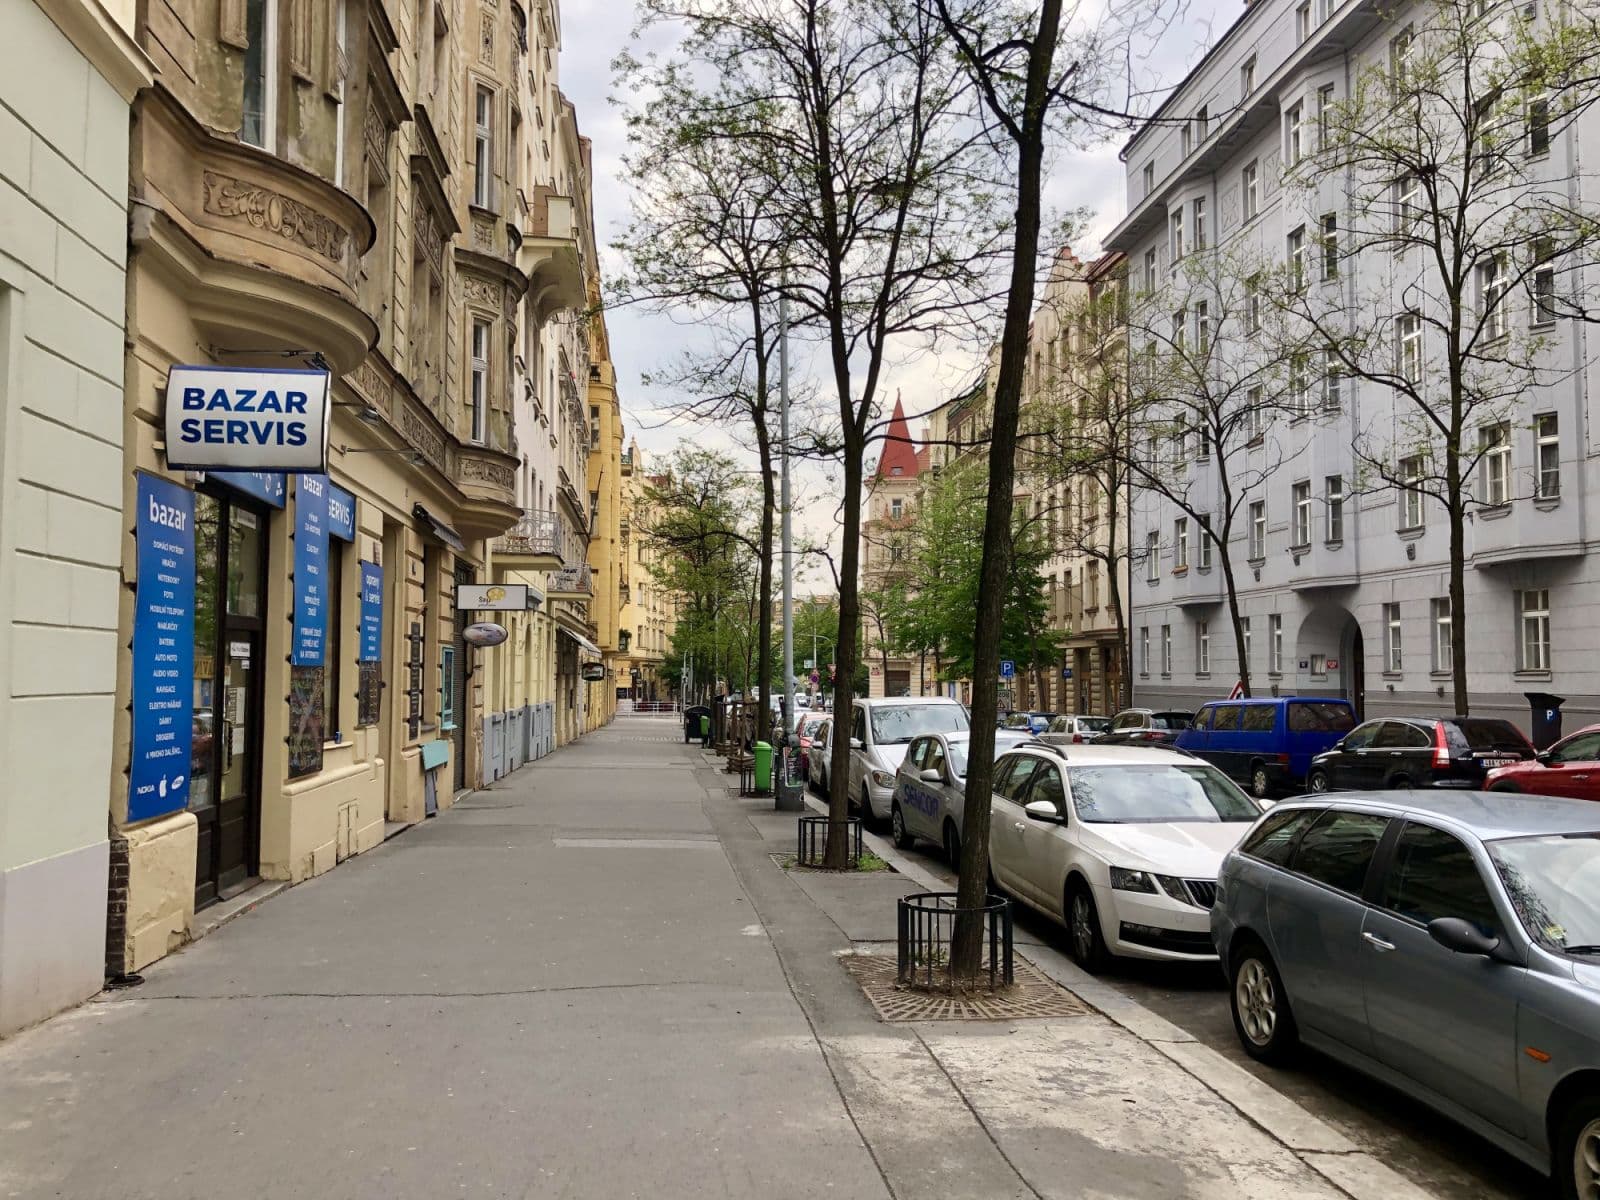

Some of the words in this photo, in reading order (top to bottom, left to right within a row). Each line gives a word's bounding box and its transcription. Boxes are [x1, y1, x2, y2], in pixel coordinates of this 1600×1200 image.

[182, 387, 308, 414] BAZAR
[180, 418, 308, 446] SERVIS
[303, 474, 323, 498] bazar
[149, 494, 186, 531] bazar
[164, 591, 174, 600] FOTO
[154, 653, 166, 662] AUTO
[166, 654, 178, 662] MOTO
[1003, 663, 1011, 673] P
[153, 669, 166, 678] AUDIO
[166, 669, 179, 678] VIDEO
[1546, 709, 1554, 721] P
[145, 752, 150, 760] A
[137, 785, 154, 795] NOKIA
